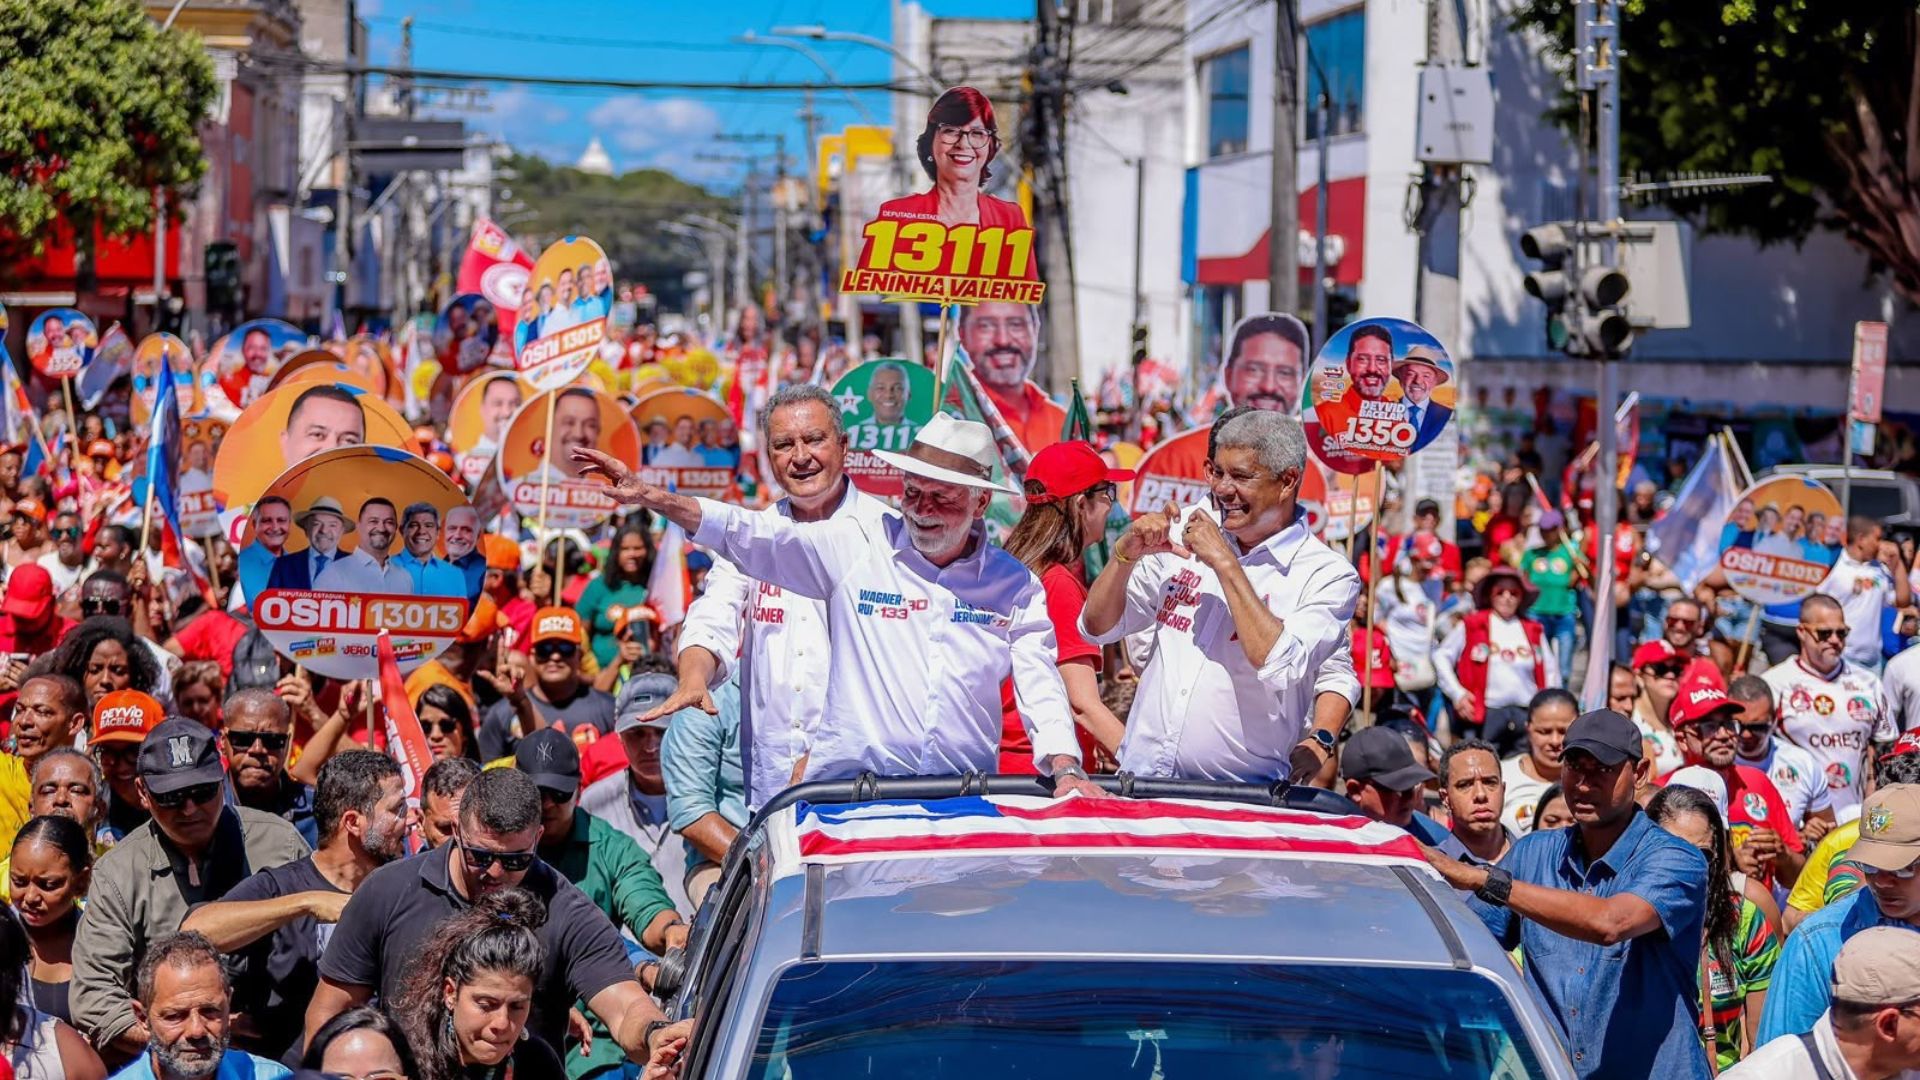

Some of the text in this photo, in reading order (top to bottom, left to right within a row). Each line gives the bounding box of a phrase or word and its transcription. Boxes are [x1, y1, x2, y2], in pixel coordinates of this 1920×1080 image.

[882, 210, 916, 219] DEPUTADA
[864, 219, 1034, 279] 13111
[841, 269, 1045, 303] LENINHA VALENTE
[1361, 399, 1406, 414] DEYVID
[847, 424, 923, 450] 1311
[1344, 416, 1417, 449] 1350
[1170, 567, 1202, 589] JERO
[278, 591, 346, 601] DEPUTADO ESTADUAL
[759, 580, 782, 598] ULA
[859, 588, 902, 605] WAGNER
[857, 603, 909, 620] RUI 133
[1163, 594, 1179, 612] RUI
[369, 601, 461, 631] 13013
[1156, 607, 1192, 633] WAGNER
[100, 717, 143, 730] BACELAR
[168, 735, 193, 767] M
